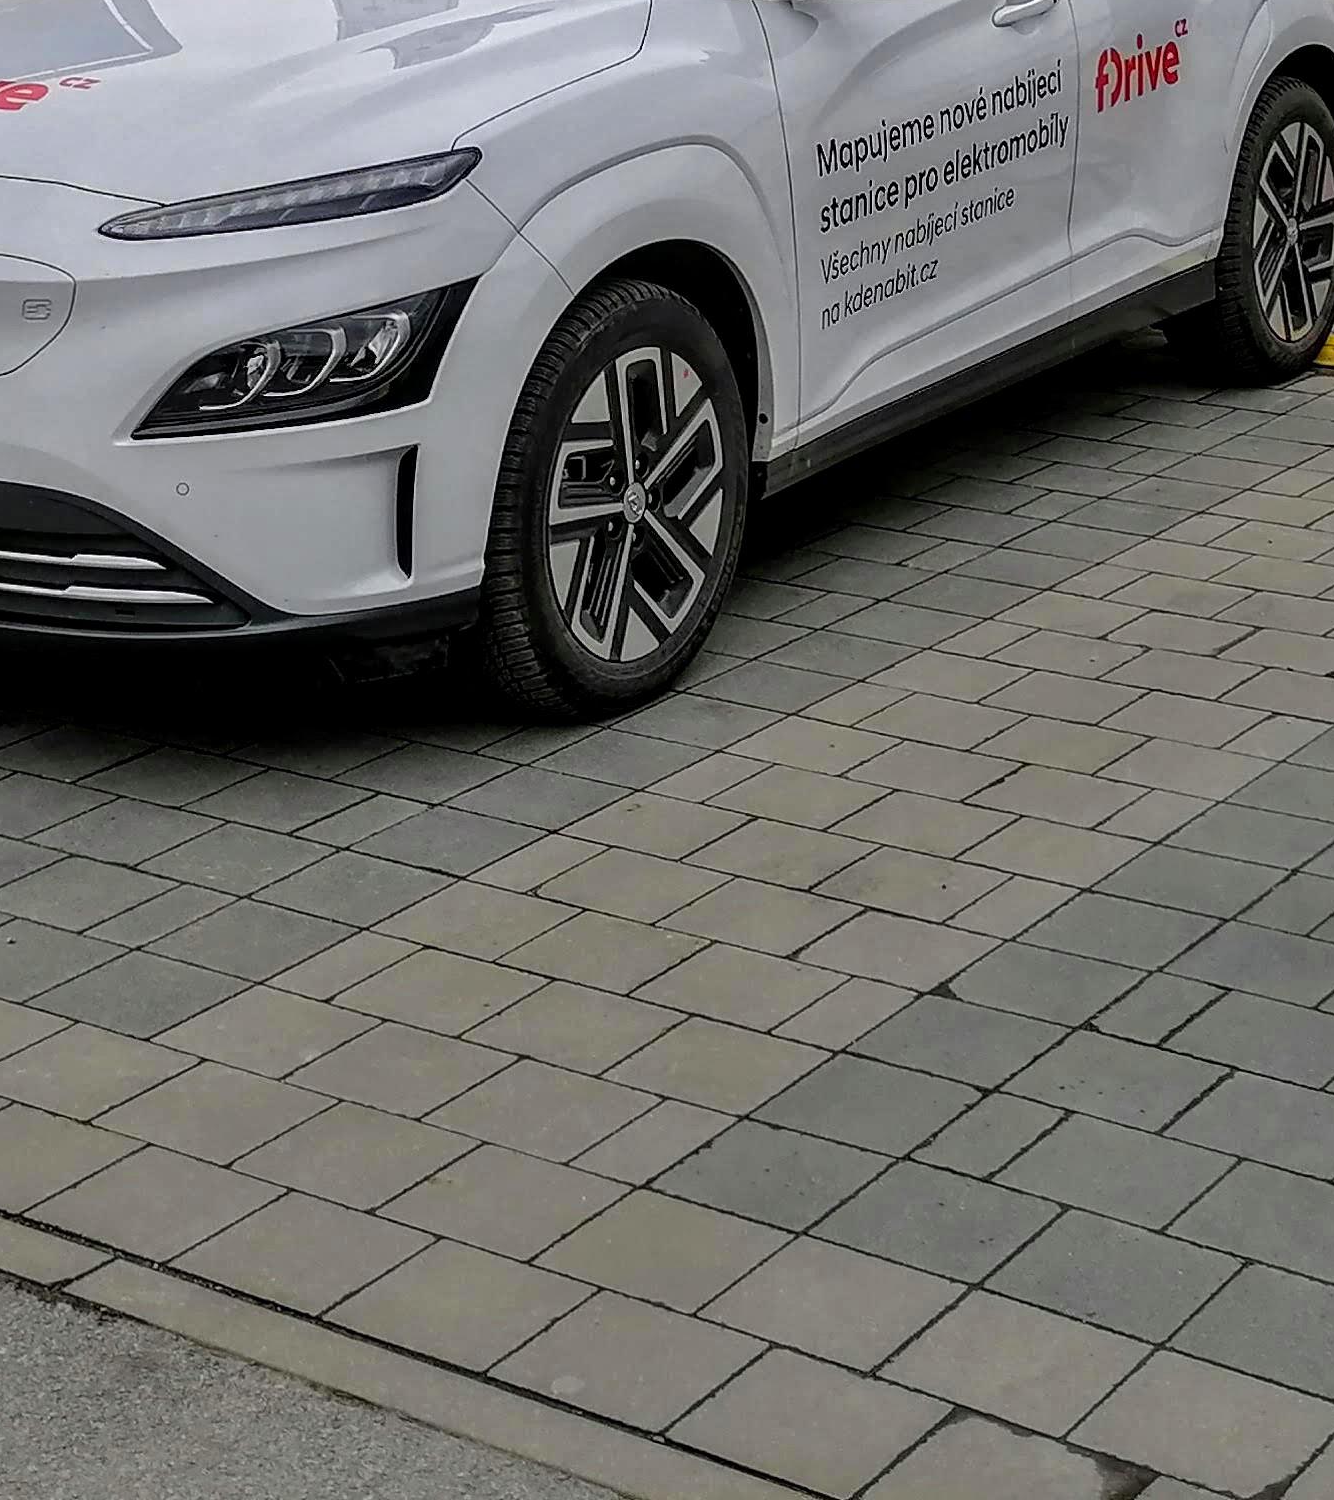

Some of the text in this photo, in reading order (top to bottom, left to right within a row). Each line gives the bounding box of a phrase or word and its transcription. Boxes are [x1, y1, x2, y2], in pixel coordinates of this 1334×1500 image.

[815, 58, 1063, 177] Mapujeme nové nabíjecí
[818, 112, 1069, 234] stanice pro elektromobily
[819, 185, 1016, 285] Všechny nabíjecí stanice
[819, 257, 940, 330] na kdenabit.cz
